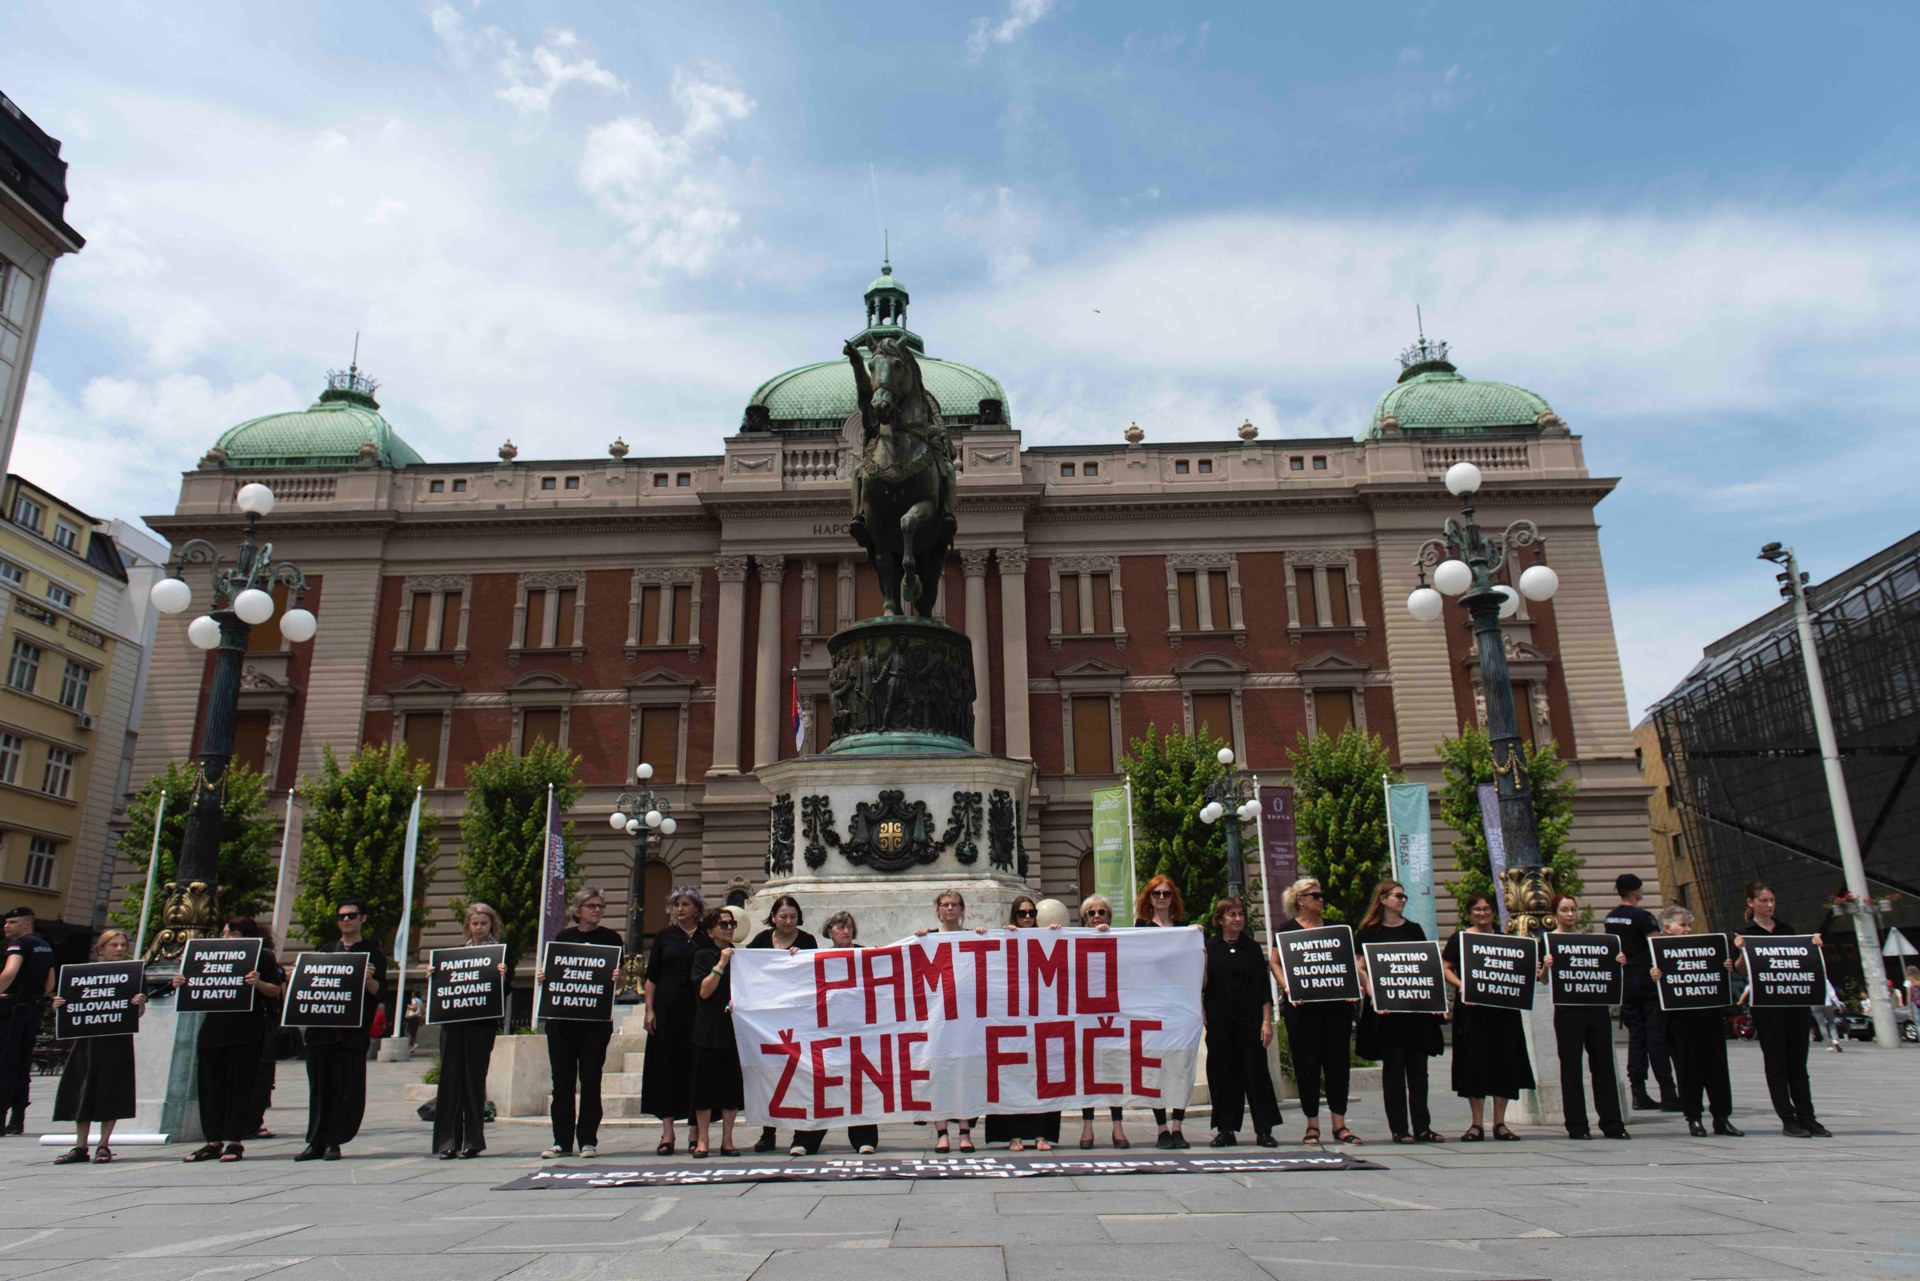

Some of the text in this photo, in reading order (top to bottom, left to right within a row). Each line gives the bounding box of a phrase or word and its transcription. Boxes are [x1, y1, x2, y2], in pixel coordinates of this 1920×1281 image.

[1400, 834, 1409, 866] IDEAS
[1419, 833, 1429, 873] SERBIA
[1409, 834, 1420, 882] CREATES
[1290, 939, 1340, 951] PAMTIMO
[1558, 945, 1608, 955] PAMTIMO
[195, 951, 246, 961] PAMTIMO
[1303, 952, 1332, 962] ŽENE
[1377, 953, 1427, 961] PAMTIMO
[1473, 945, 1524, 958] PAMTIMO
[1664, 948, 1715, 958] PAMTIMO
[1755, 947, 1807, 956] PAMTIMO
[441, 958, 491, 970] PAMTIMO
[555, 956, 605, 967] PAMTIMO
[1484, 957, 1513, 969] ŽENE
[1570, 956, 1598, 967] ŽENE
[1677, 960, 1707, 970] ŽENE
[1770, 959, 1800, 968] ŽENE
[203, 964, 232, 973] ŽENE
[304, 965, 354, 974] PAMTIMO
[563, 968, 593, 980] ŽENE
[1294, 964, 1347, 975] SILOVANE
[1390, 964, 1419, 973] ŽENE
[71, 974, 128, 986] PAMTIMO
[450, 971, 479, 982] ŽENE
[1472, 969, 1525, 984] SILOVANE
[1559, 970, 1611, 980] SILOVANE
[1666, 973, 1720, 983] SILOVANE
[1759, 973, 1814, 982] SILOVANE
[188, 977, 243, 986] SILOVANE
[311, 976, 340, 987] ŽENE
[814, 937, 1120, 1028] PAMTIMO
[1301, 977, 1343, 988] U RATU!
[1380, 977, 1434, 986] SILOVANE
[82, 987, 115, 999] ŽENE
[437, 983, 491, 996] SILOVANE
[549, 983, 603, 994] SILOVANE
[1477, 983, 1520, 996] U RATU!
[1564, 983, 1607, 993] U RATU!
[1674, 986, 1717, 996] U RATU!
[1766, 985, 1810, 994] U RATU!
[191, 990, 236, 999] U RATU!
[296, 991, 351, 1000] SILOVANE
[1387, 989, 1430, 999] U RATU!
[67, 1000, 128, 1012] SILOVANE
[442, 996, 486, 1009] U RATU!
[552, 996, 596, 1007] U RATU!
[300, 1004, 345, 1014] U RATU!
[72, 1013, 122, 1025] U RATU!
[760, 1016, 1163, 1119] ŽENE FOČE
